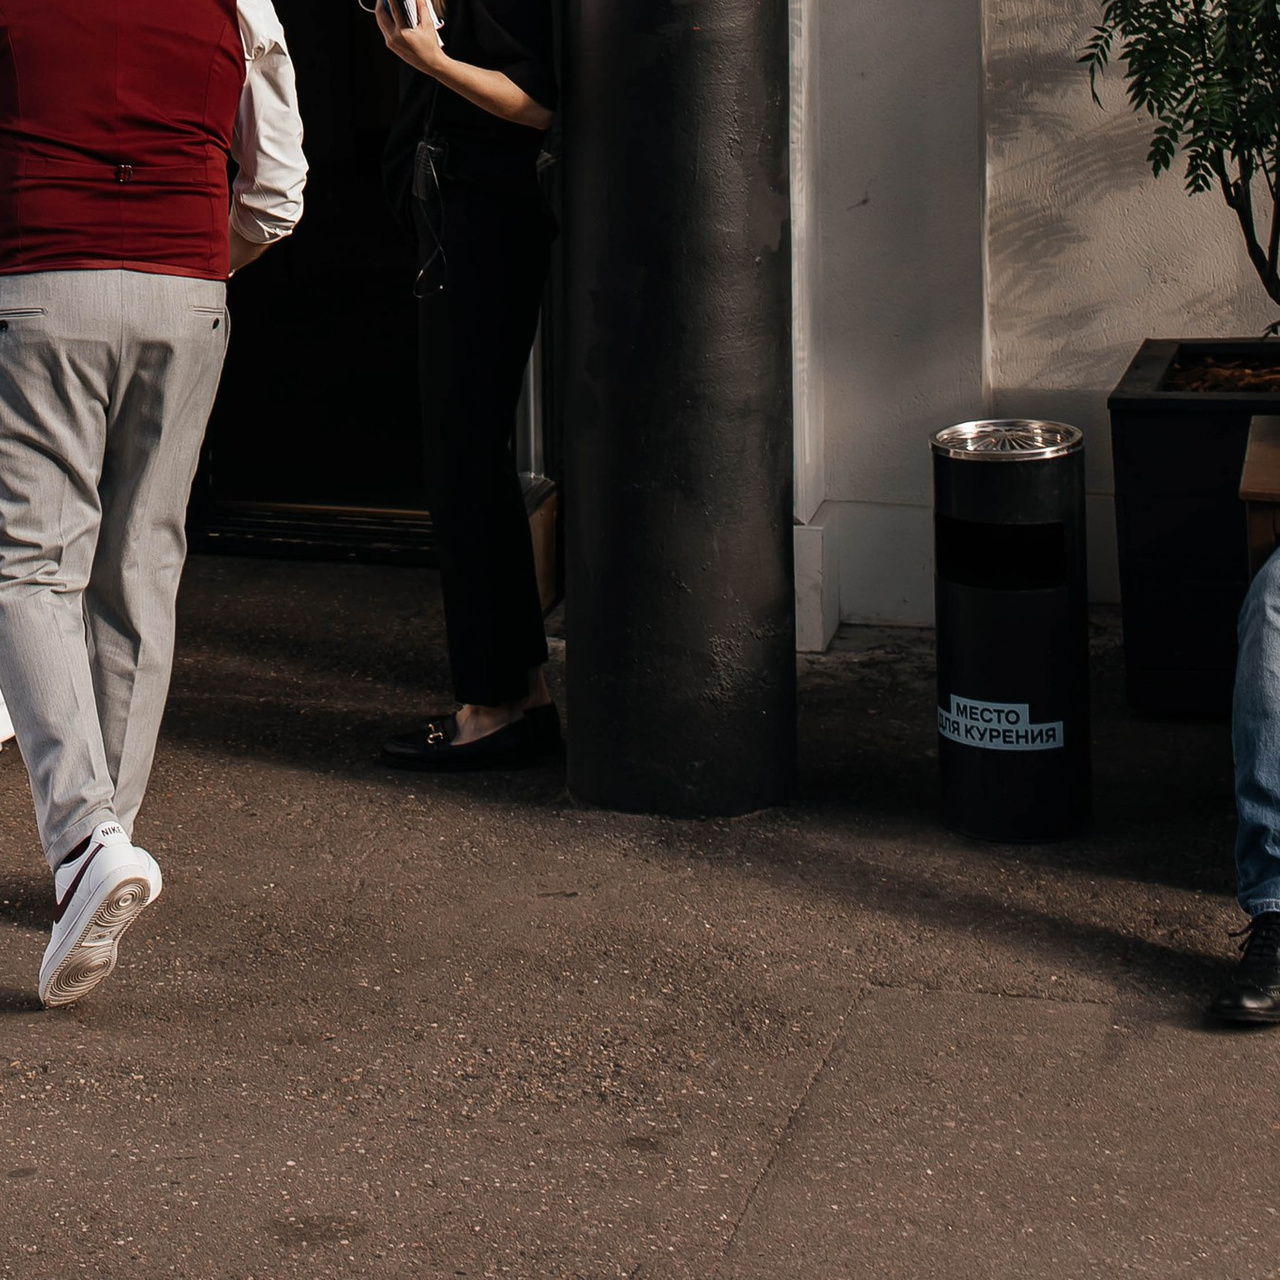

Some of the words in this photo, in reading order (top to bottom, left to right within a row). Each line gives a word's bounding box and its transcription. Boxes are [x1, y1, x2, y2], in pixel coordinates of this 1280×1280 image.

[956, 702, 1020, 725] МЕСТО
[965, 724, 1056, 744] КУРЕНИЯ
[101, 826, 123, 837] NIKE
